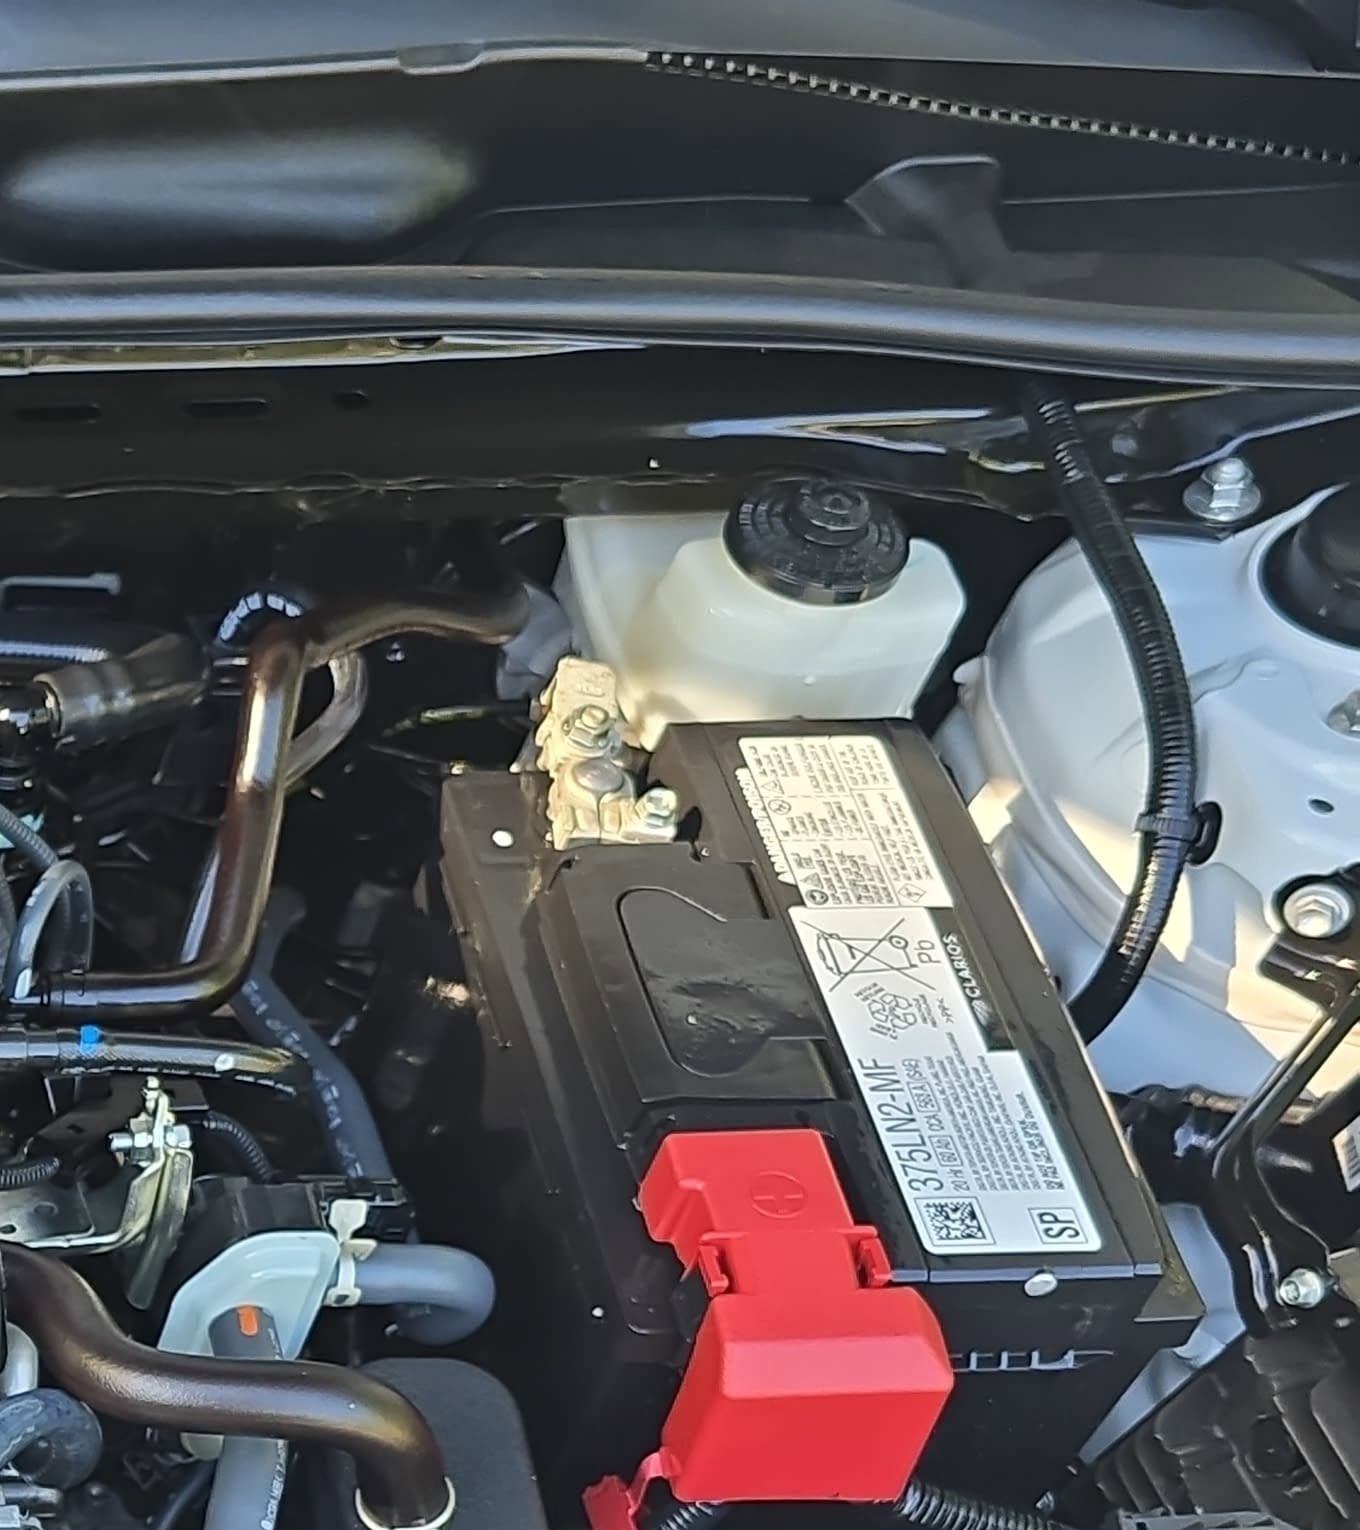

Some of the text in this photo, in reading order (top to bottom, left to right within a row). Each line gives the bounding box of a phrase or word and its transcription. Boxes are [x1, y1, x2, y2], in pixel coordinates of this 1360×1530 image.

[914, 939, 941, 964] Pb
[942, 932, 981, 1000] CLARIOS
[858, 1058, 944, 1192] 375LN2-MF
[1037, 1212, 1080, 1239] SP
